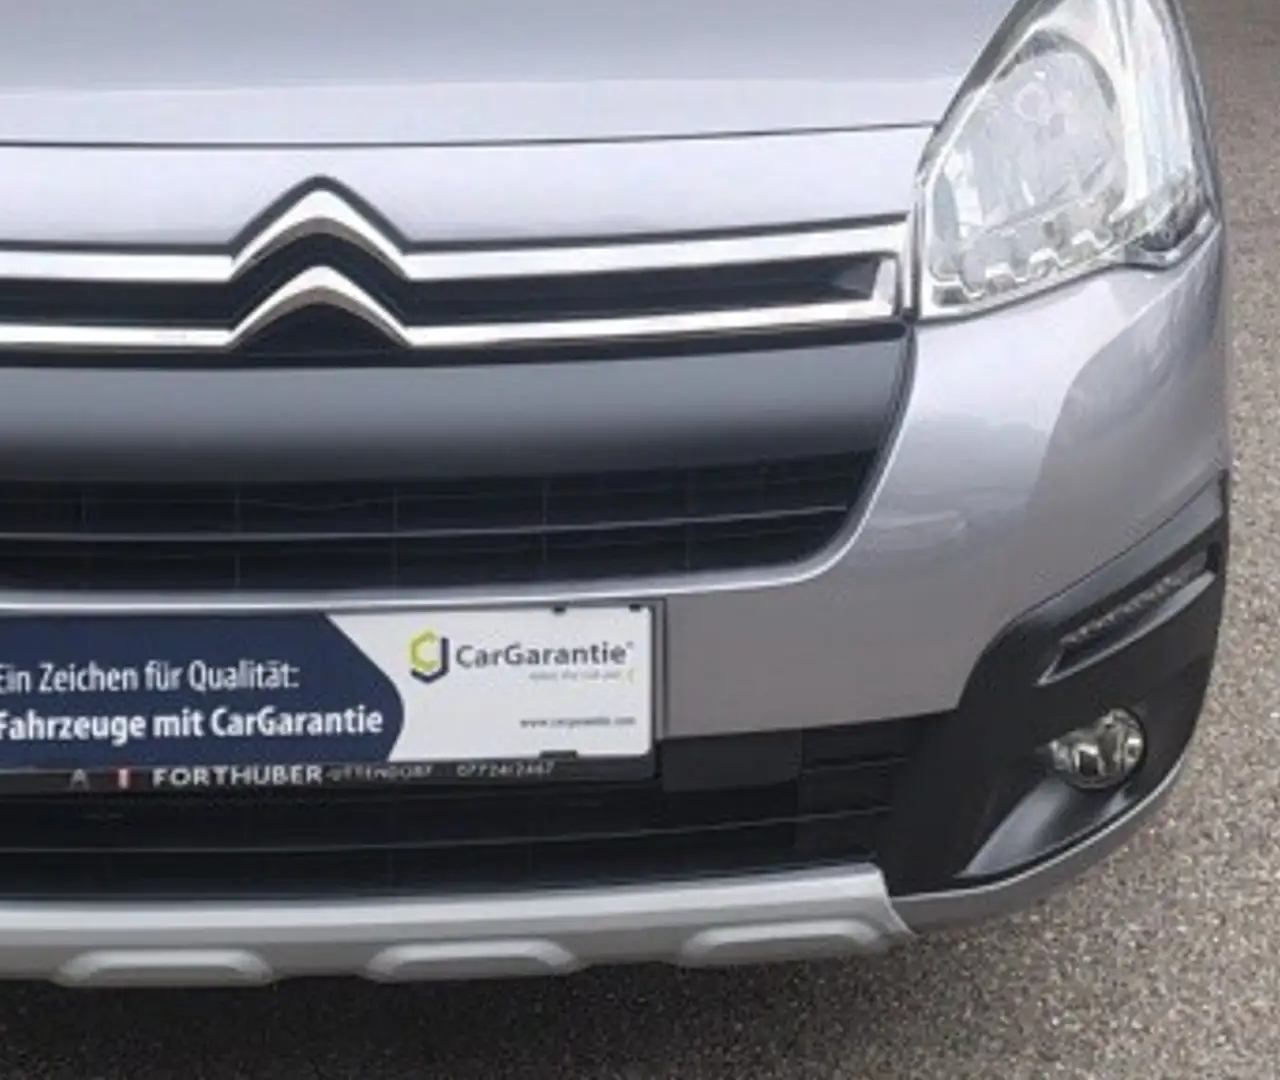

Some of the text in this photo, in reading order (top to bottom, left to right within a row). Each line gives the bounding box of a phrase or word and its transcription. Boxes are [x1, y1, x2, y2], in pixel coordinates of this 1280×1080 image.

[38, 660, 139, 693] Zeichen
[145, 660, 182, 692] für
[187, 659, 300, 694] Qualität:
[152, 707, 206, 737] mit
[210, 704, 384, 737] CarGarantie
[152, 764, 322, 787] FORTHUBER
